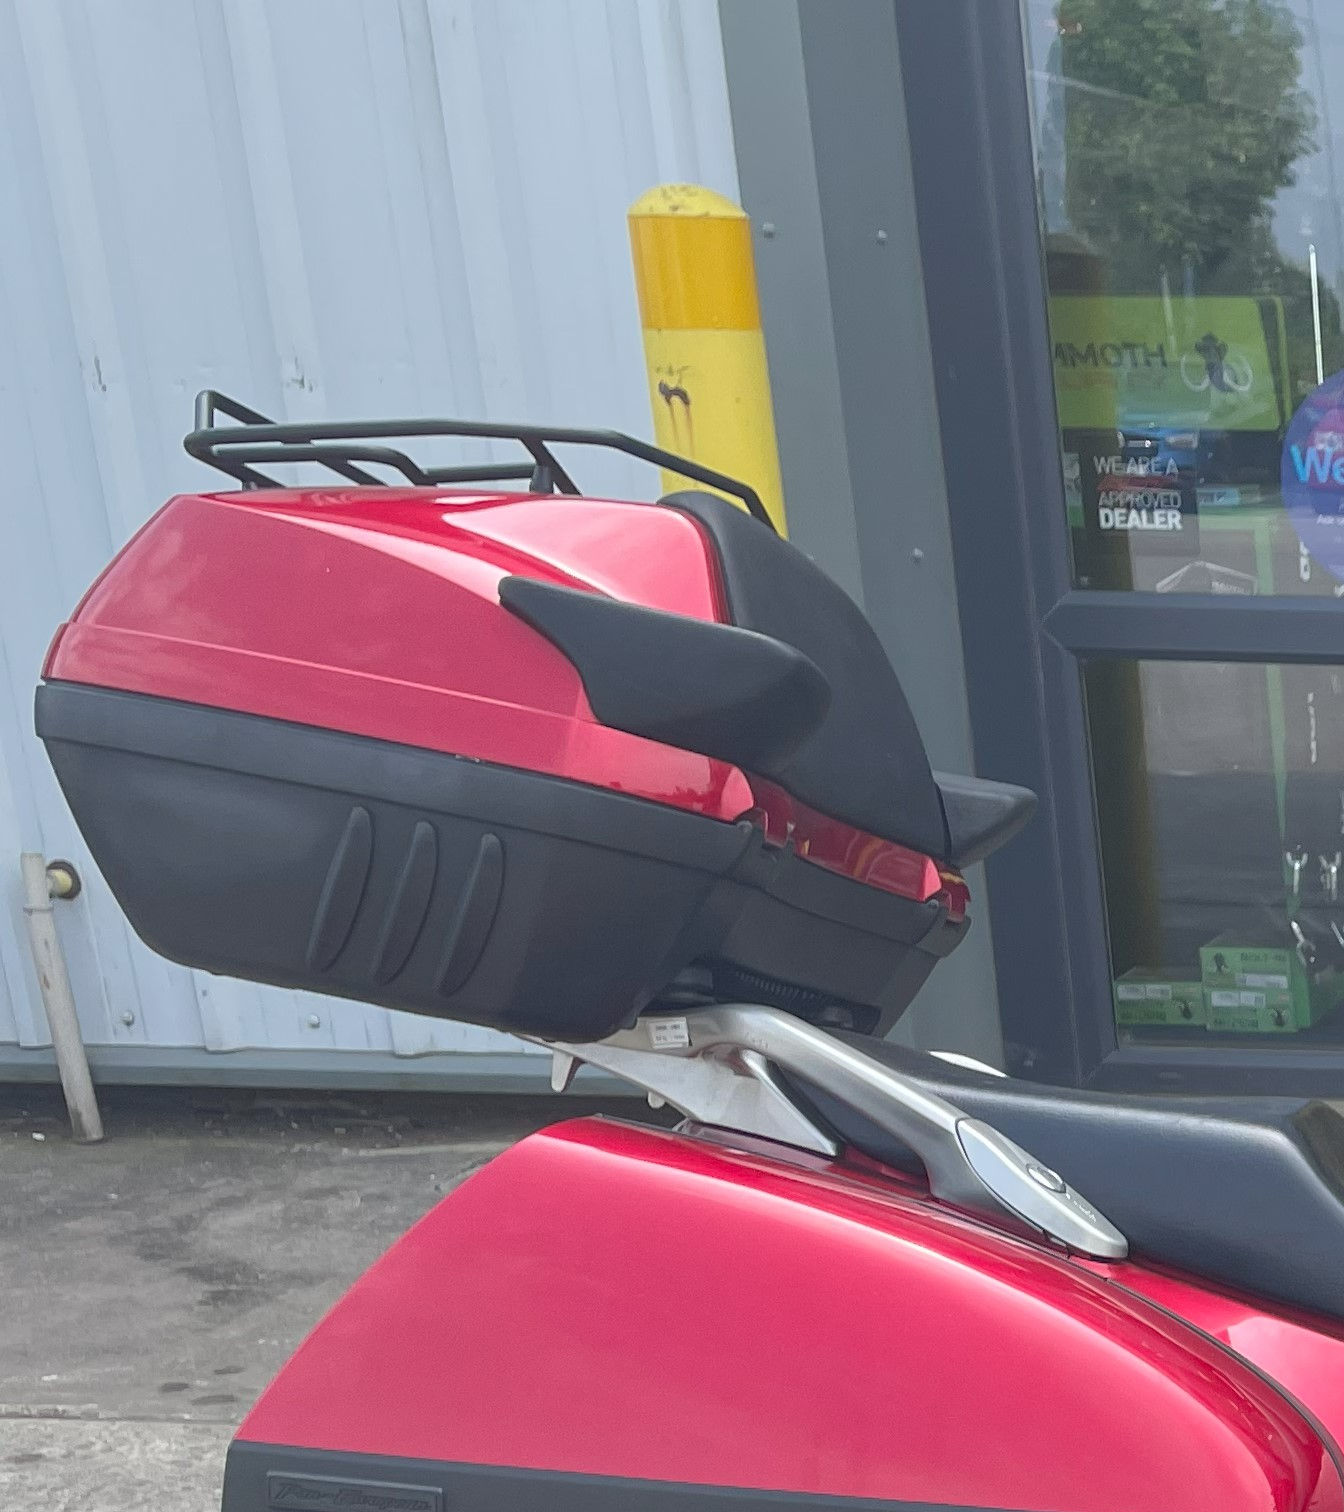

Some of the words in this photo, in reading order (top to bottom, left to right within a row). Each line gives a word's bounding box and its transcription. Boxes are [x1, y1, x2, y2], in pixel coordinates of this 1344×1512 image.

[1094, 456, 1122, 475] WE
[1126, 457, 1162, 476] ARE
[1165, 457, 1179, 475] A
[1099, 490, 1182, 509] APPROVED
[1100, 508, 1183, 531] DEALER
